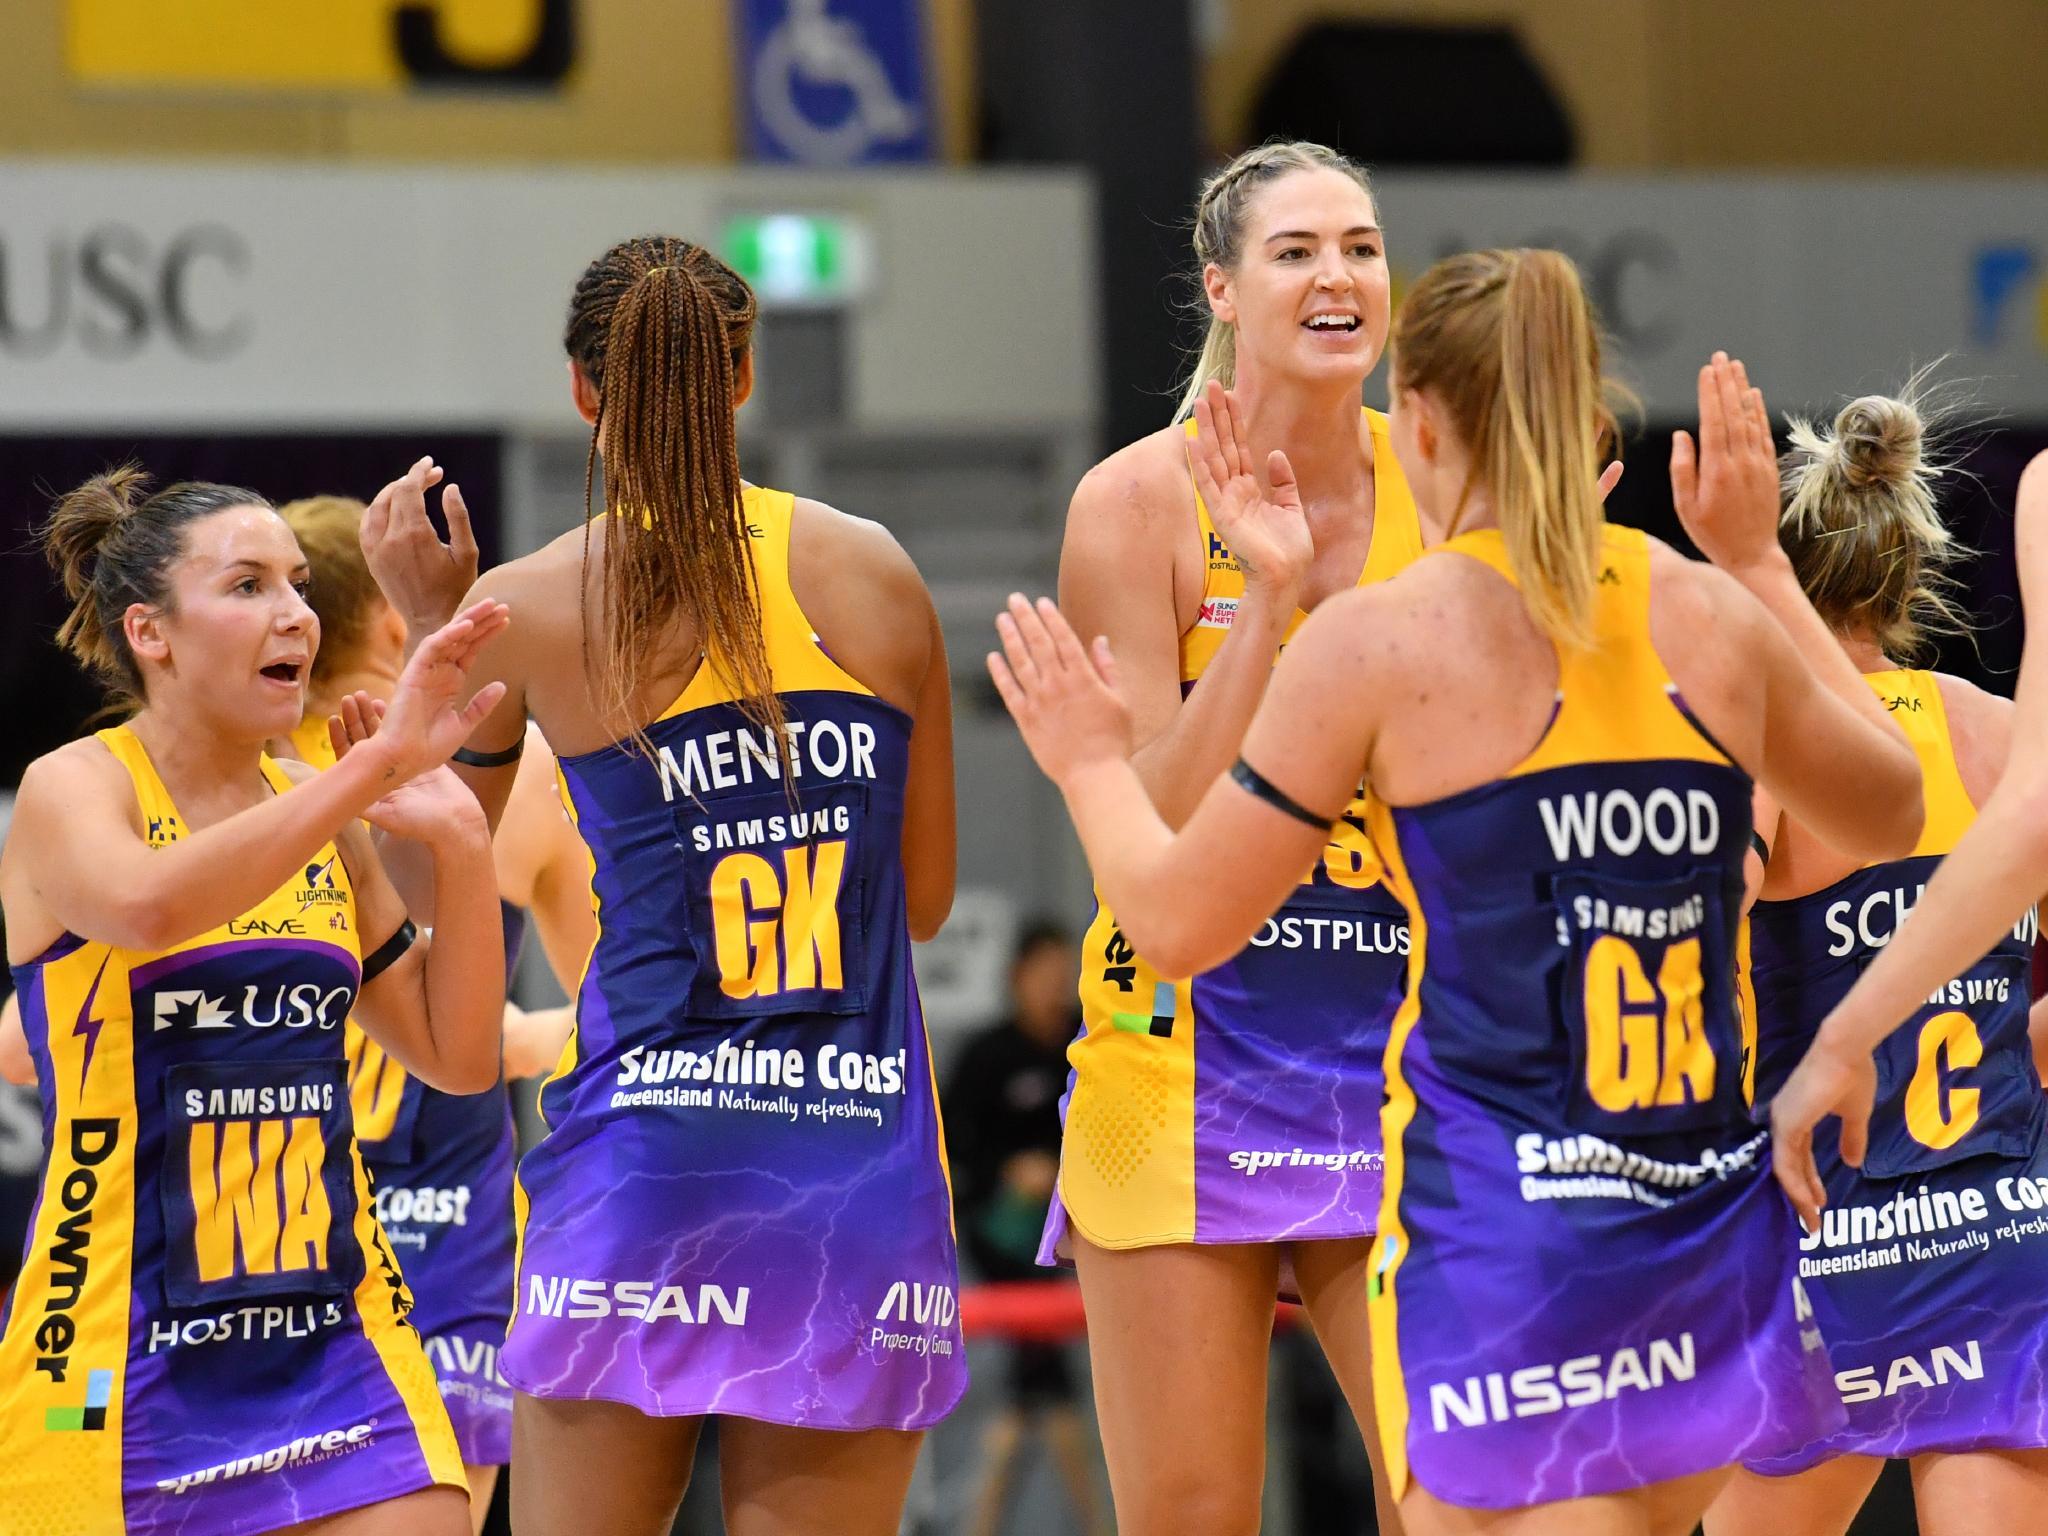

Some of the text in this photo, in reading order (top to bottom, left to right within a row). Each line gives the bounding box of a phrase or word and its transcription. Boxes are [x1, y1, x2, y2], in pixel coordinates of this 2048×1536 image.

[659, 719, 877, 802] MENTOR
[692, 805, 850, 852] SAMSUNG
[1538, 788, 1720, 862] WOOD
[296, 889, 347, 904] LIGHTNING
[329, 911, 348, 931] #2
[710, 839, 846, 1000] GK
[243, 984, 351, 1030] USC
[1584, 934, 1716, 1113] GA
[617, 1038, 805, 1087] Sunshine
[1904, 1011, 1983, 1150] C
[185, 1083, 333, 1117] SAMSUNG
[610, 1085, 883, 1128] Queensland Naturally refreshing
[188, 1117, 329, 1284] WA
[35, 1117, 121, 1383] Downer
[1799, 1243, 1902, 1278] Queensland
[1906, 1231, 1990, 1262] Naturally
[525, 1273, 750, 1326] NISSAN
[875, 1281, 956, 1327] AVID
[871, 1327, 930, 1356] Property
[1429, 1332, 1697, 1433] NISSAN
[156, 1423, 373, 1495] springfree
[288, 1437, 377, 1470] TRAMPOLINE
